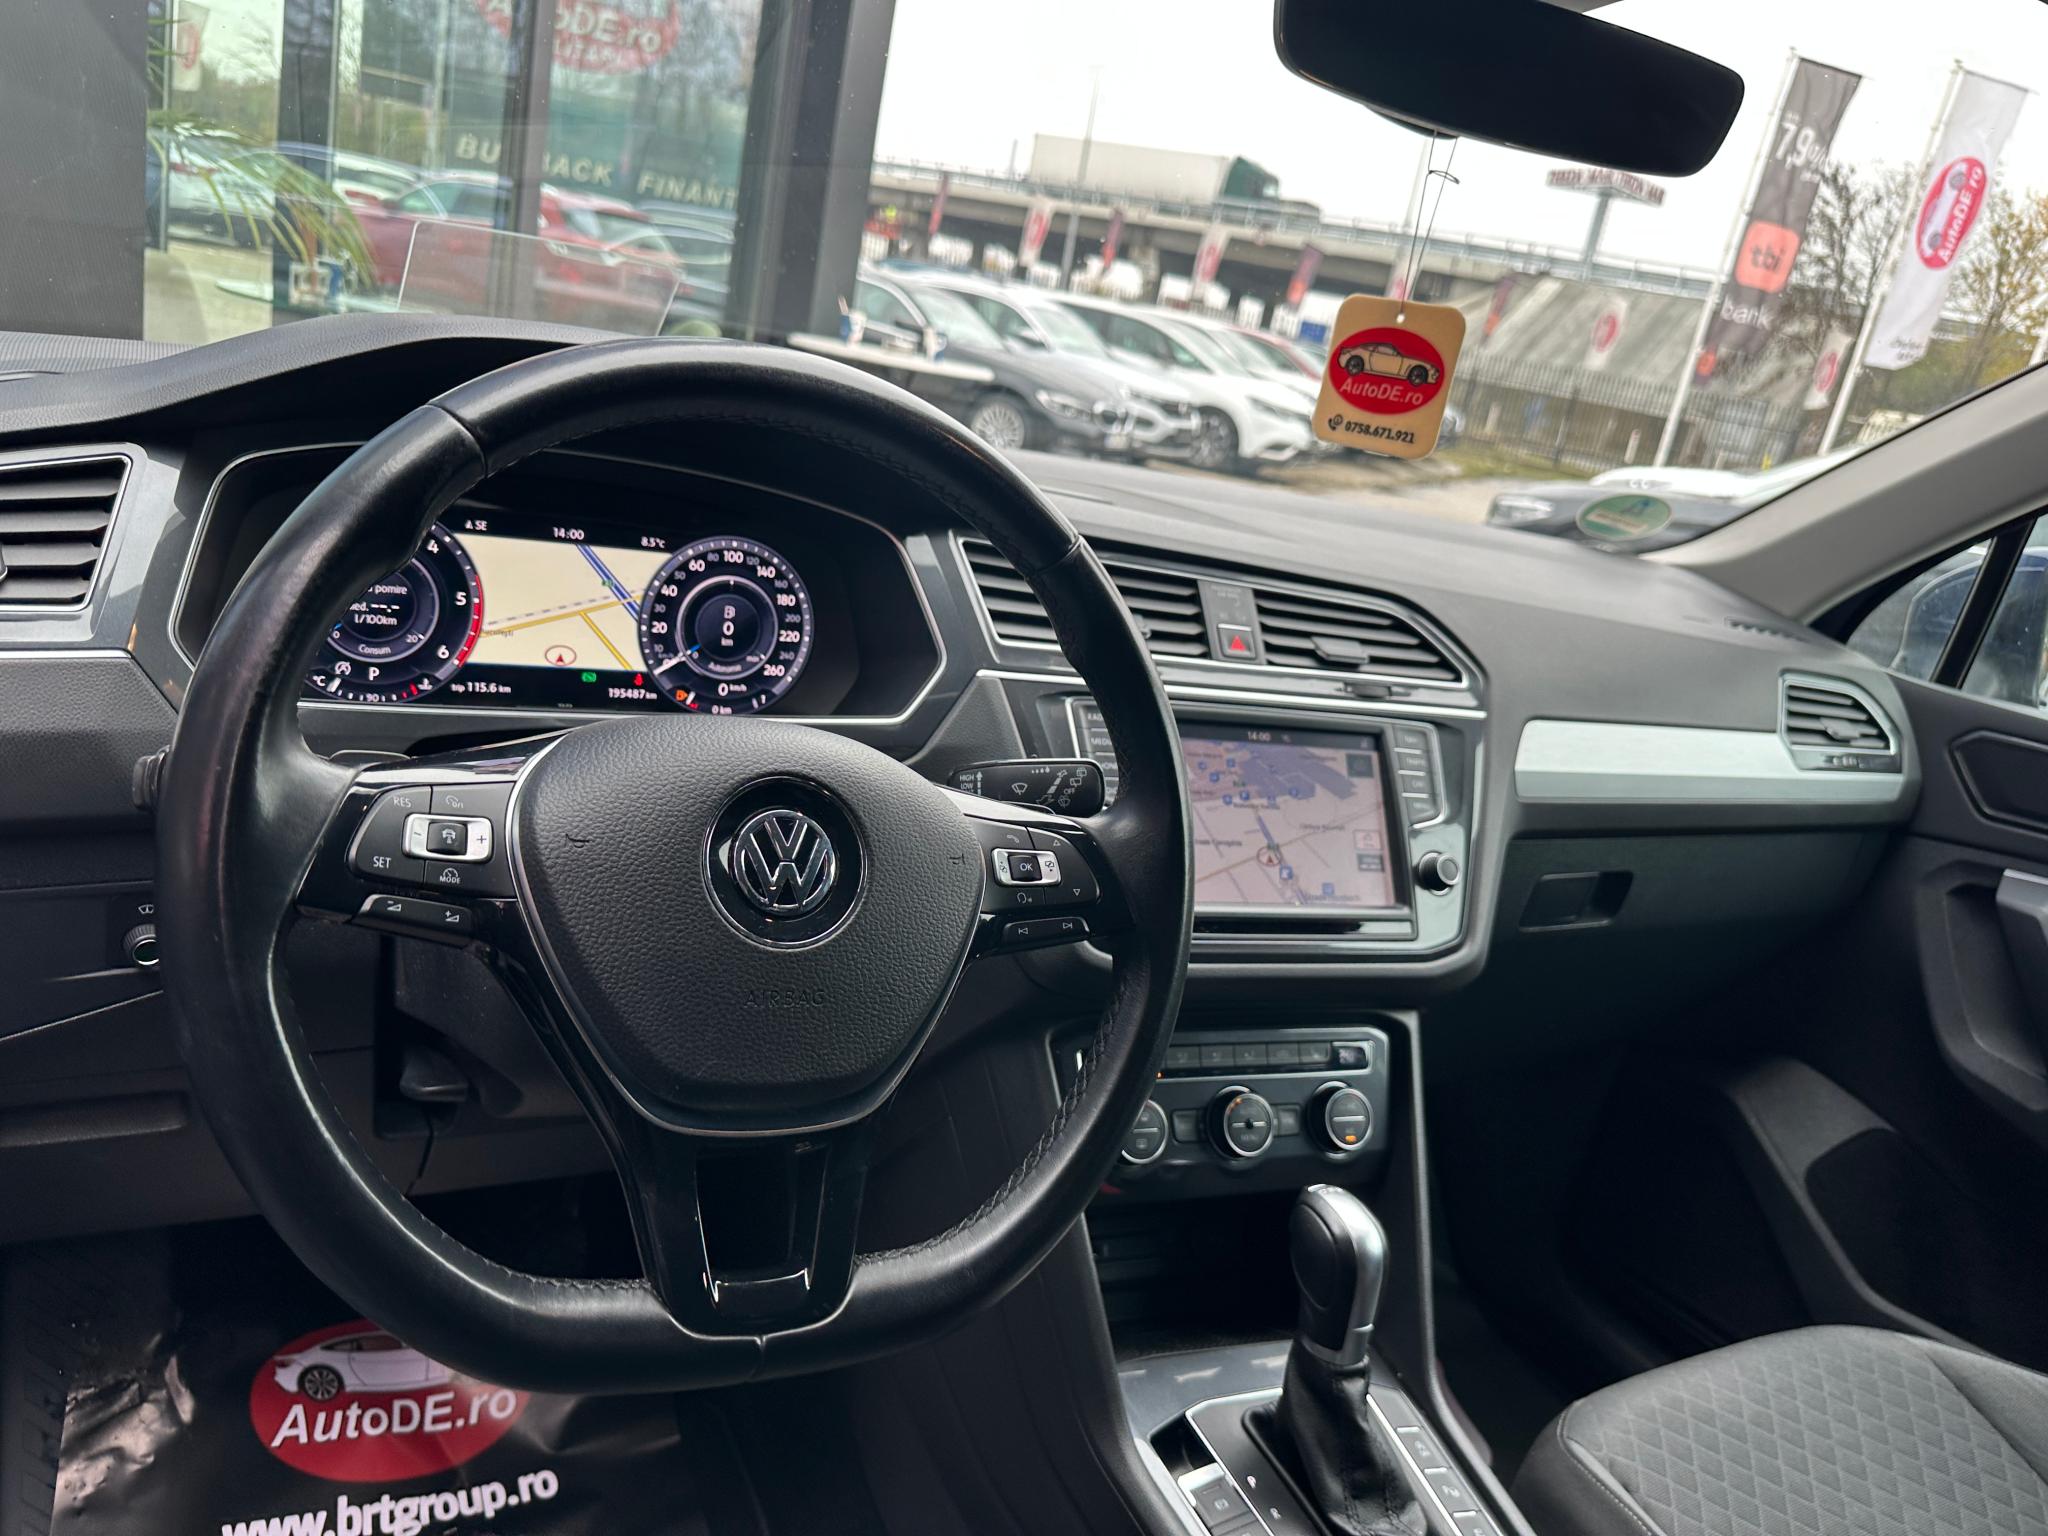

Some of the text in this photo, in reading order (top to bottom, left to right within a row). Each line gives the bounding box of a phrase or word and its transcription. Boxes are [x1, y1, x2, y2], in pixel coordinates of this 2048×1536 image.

[1752, 244, 1784, 272] tbi
[1720, 296, 1774, 330] bank
[1339, 377, 1424, 405] AutoDE.ro
[1344, 420, 1415, 444] 0758.671.921
[553, 527, 585, 540] 14:00
[427, 540, 439, 554] 4
[707, 552, 720, 562] 80
[723, 550, 743, 563] 100
[746, 556, 760, 566] 120
[688, 559, 705, 572] 60
[674, 571, 686, 580] 50
[757, 566, 776, 578] 140
[774, 579, 788, 589] 160
[661, 585, 678, 597] 40
[455, 592, 467, 606] 5
[776, 594, 796, 607] 180
[654, 604, 666, 613] 30
[785, 614, 801, 623] 200
[651, 622, 668, 634] 20
[722, 622, 735, 636] 0
[779, 630, 800, 643] 220
[358, 644, 392, 654] Consum
[436, 645, 449, 659] 6
[779, 651, 795, 660] 240
[368, 667, 380, 681] P
[763, 664, 785, 677] 260
[451, 683, 465, 693] trip
[467, 682, 497, 693] 115.6
[608, 687, 645, 699] 195487
[718, 683, 729, 697] 0
[959, 774, 974, 782] HIGH
[960, 782, 974, 790] LOW
[393, 796, 412, 808] RES
[373, 855, 392, 869] SET
[1020, 862, 1033, 871] OK
[439, 875, 461, 885] MODE
[271, 1388, 518, 1448] AutoDE.ro
